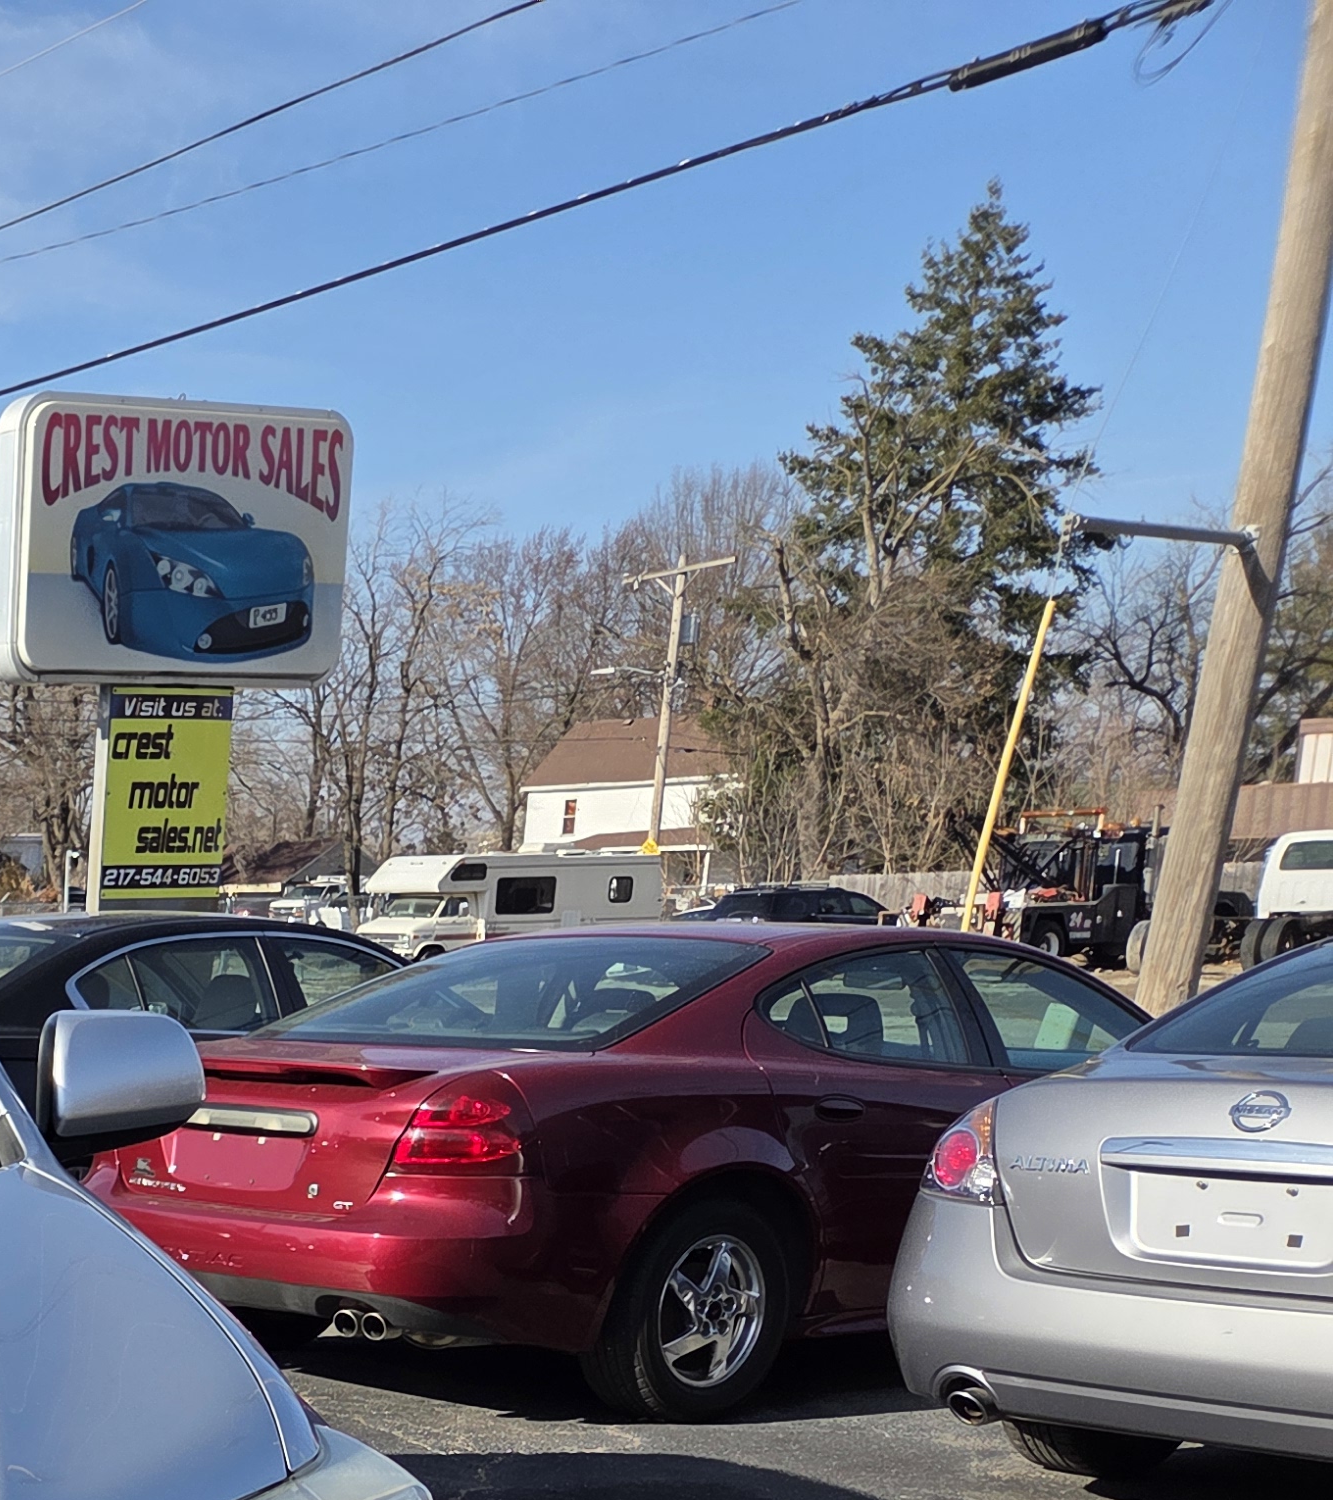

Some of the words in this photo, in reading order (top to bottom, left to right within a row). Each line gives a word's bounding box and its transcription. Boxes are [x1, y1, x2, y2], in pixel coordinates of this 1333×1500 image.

[41, 411, 140, 507] CREST
[146, 418, 251, 480] MOTOR
[258, 424, 344, 522] SALES
[124, 697, 166, 717] Visit
[171, 701, 197, 717] us
[201, 698, 223, 717] at:
[112, 723, 174, 760] crest
[128, 773, 200, 809] motor
[135, 818, 222, 853] sales.net
[103, 868, 221, 886] 217-544-6053
[1009, 1155, 1090, 1175] ALTIMA
